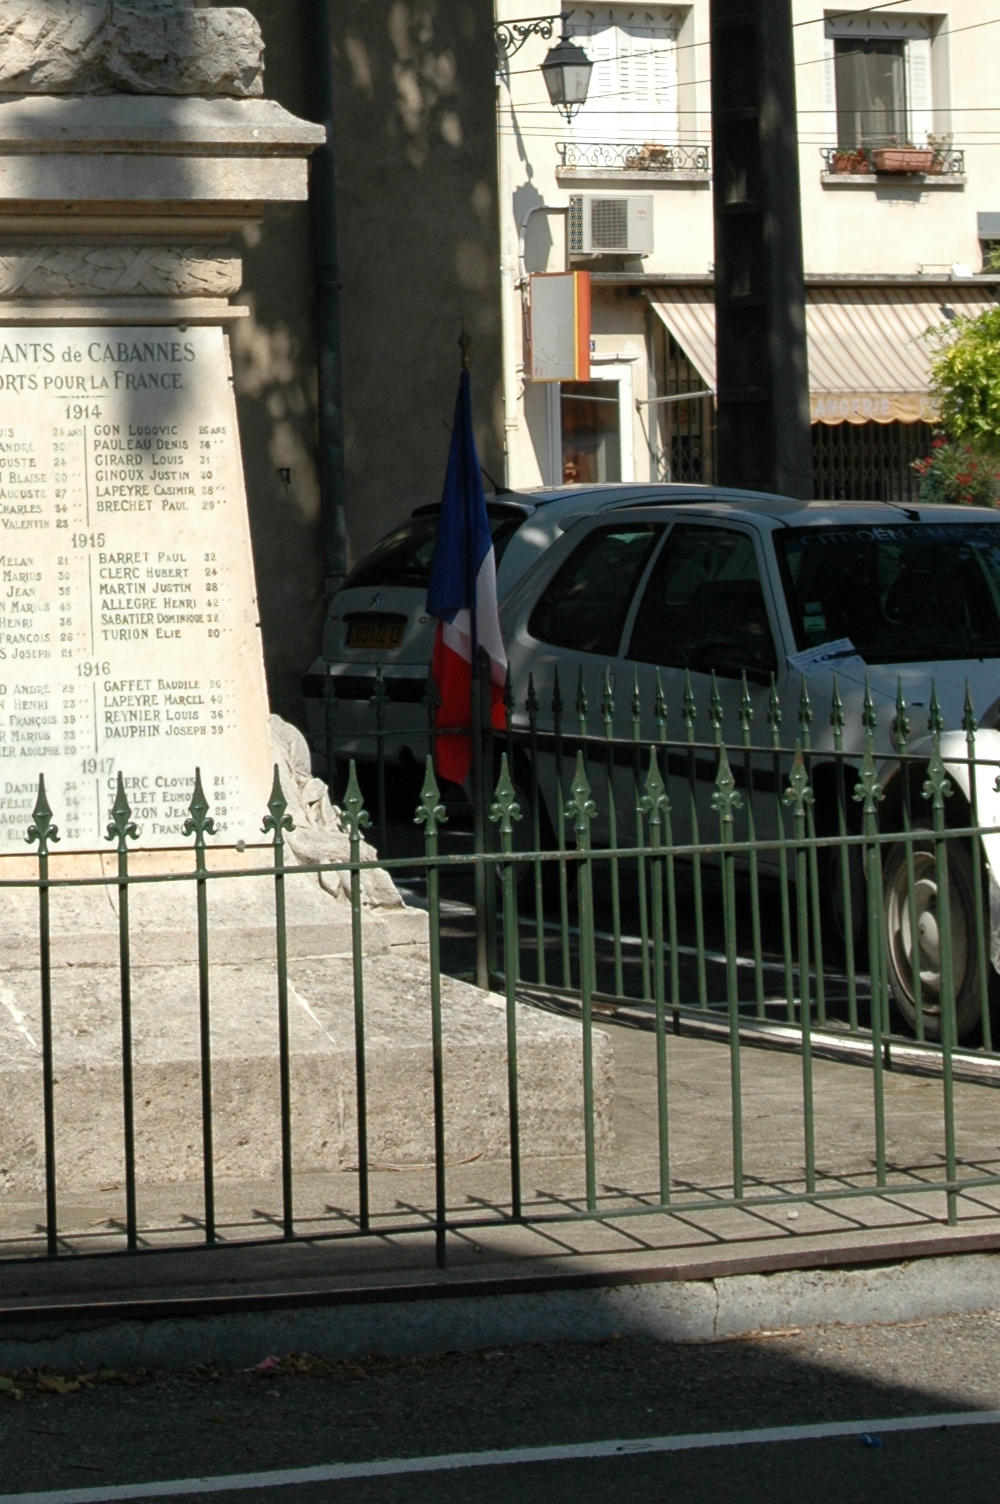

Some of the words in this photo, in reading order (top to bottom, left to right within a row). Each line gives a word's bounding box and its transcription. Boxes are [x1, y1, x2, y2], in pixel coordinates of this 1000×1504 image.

[62, 347, 82, 363] de
[88, 343, 195, 362] CABANNES
[44, 376, 88, 392] POUR
[90, 376, 109, 389] LA
[114, 371, 183, 392] FRANCE
[65, 404, 102, 419] 1914
[814, 398, 890, 417] ANGERIE
[94, 425, 120, 436] GON
[129, 426, 178, 435] LUDOVIC
[94, 440, 150, 451] PAULEAU
[157, 440, 188, 449] DENIS
[54, 458, 66, 466] 24
[95, 454, 142, 466] GIRARD
[152, 454, 183, 465] LOUIS
[10, 474, 47, 483] BLAISE
[96, 470, 143, 481] GINOUX
[150, 470, 189, 480] JUSTIN
[0, 489, 46, 499] AUGUSTE
[96, 485, 149, 496] LAPEYRE
[154, 485, 194, 496] CASIMIR
[97, 500, 152, 512] BRECHET
[162, 500, 188, 511] PAUL
[202, 501, 214, 510] 29
[2, 519, 49, 529] VALENTIN
[71, 533, 105, 548] 1915
[801, 528, 908, 545] CITROËN
[99, 553, 149, 565] BARRET
[158, 553, 186, 562] PAUL
[3, 570, 42, 582] MARIUS
[58, 571, 70, 580] 30
[100, 568, 140, 579] CLERC
[147, 567, 189, 578] HUBERT
[205, 568, 217, 576] 24
[7, 586, 36, 597] JEAN
[100, 583, 146, 595] MARTIN
[153, 582, 191, 593] JUSTIN
[11, 601, 50, 613] MARIUS
[101, 598, 157, 610] ALLEGRE
[164, 598, 196, 609] HENRI
[0, 617, 33, 629] HENRI
[102, 613, 153, 625] SABATIER
[207, 614, 219, 622] 32
[102, 628, 148, 640] TURION
[156, 628, 181, 638] ELIE
[12, 648, 50, 659] JOSEPH
[76, 662, 111, 677] 1916
[104, 680, 152, 692] GAFFET
[158, 679, 200, 690] BAUDILE
[15, 699, 48, 710] HENRI
[104, 695, 158, 707] LAPEYRE
[164, 694, 204, 706] MARCEL
[105, 710, 161, 724] REYNIER
[166, 709, 199, 721] LOUIS
[211, 710, 223, 719] 36
[11, 730, 50, 742] MARIUS
[105, 725, 159, 738] DAUPHIN
[166, 725, 206, 735] JOSEPH
[21, 746, 60, 757] ADOLPHE
[81, 758, 114, 775] 1917
[108, 777, 148, 789] CERC
[155, 776, 195, 787] CLOVIS
[163, 792, 193, 802] EDMO
